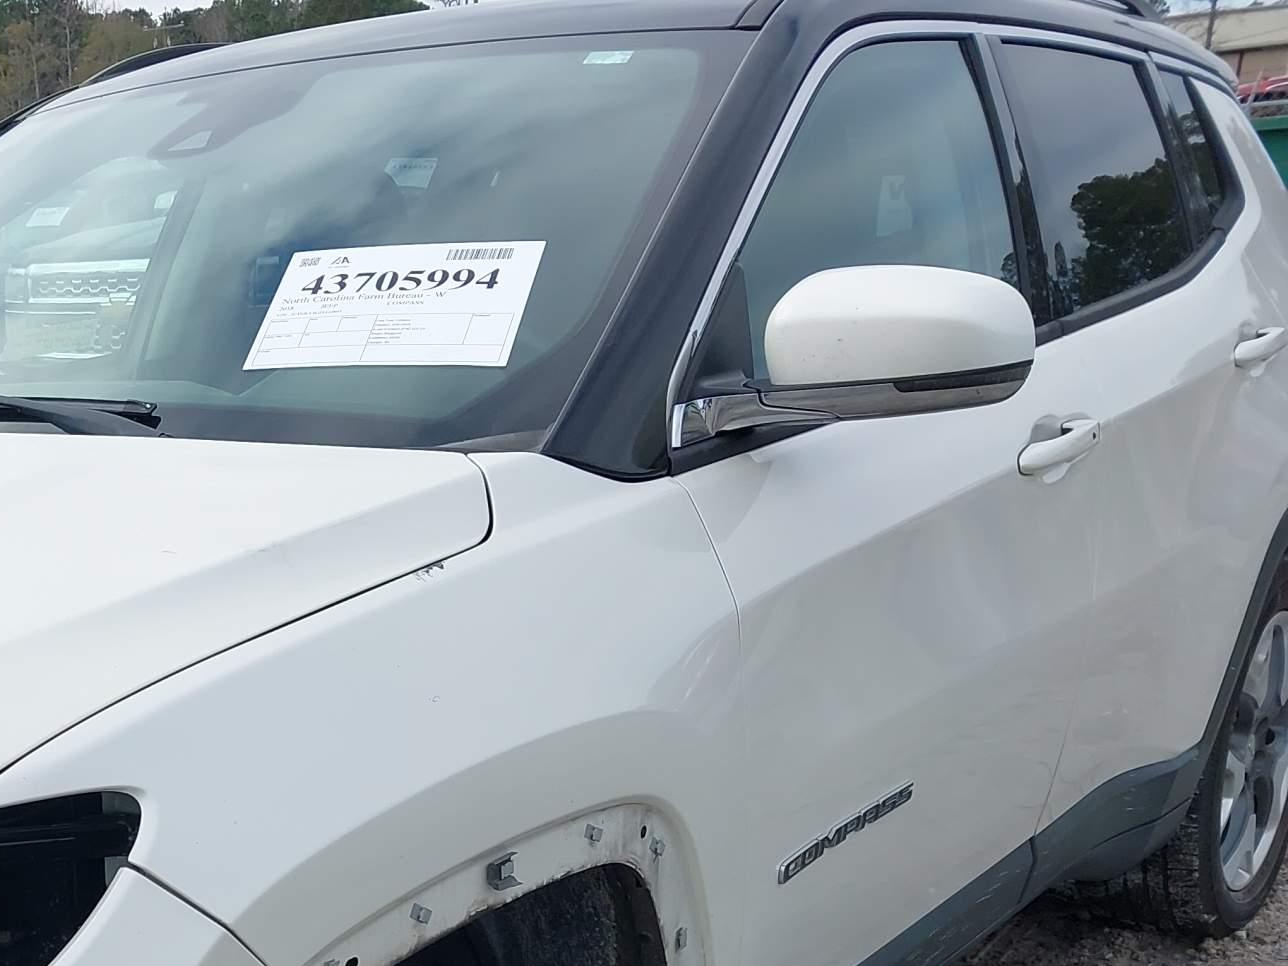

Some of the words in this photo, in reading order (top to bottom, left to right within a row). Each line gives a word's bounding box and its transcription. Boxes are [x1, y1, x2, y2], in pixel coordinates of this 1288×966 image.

[301, 268, 500, 295] 43705994
[281, 294, 311, 305] North
[312, 292, 356, 303] Carolina
[778, 780, 914, 884] COMPASS
